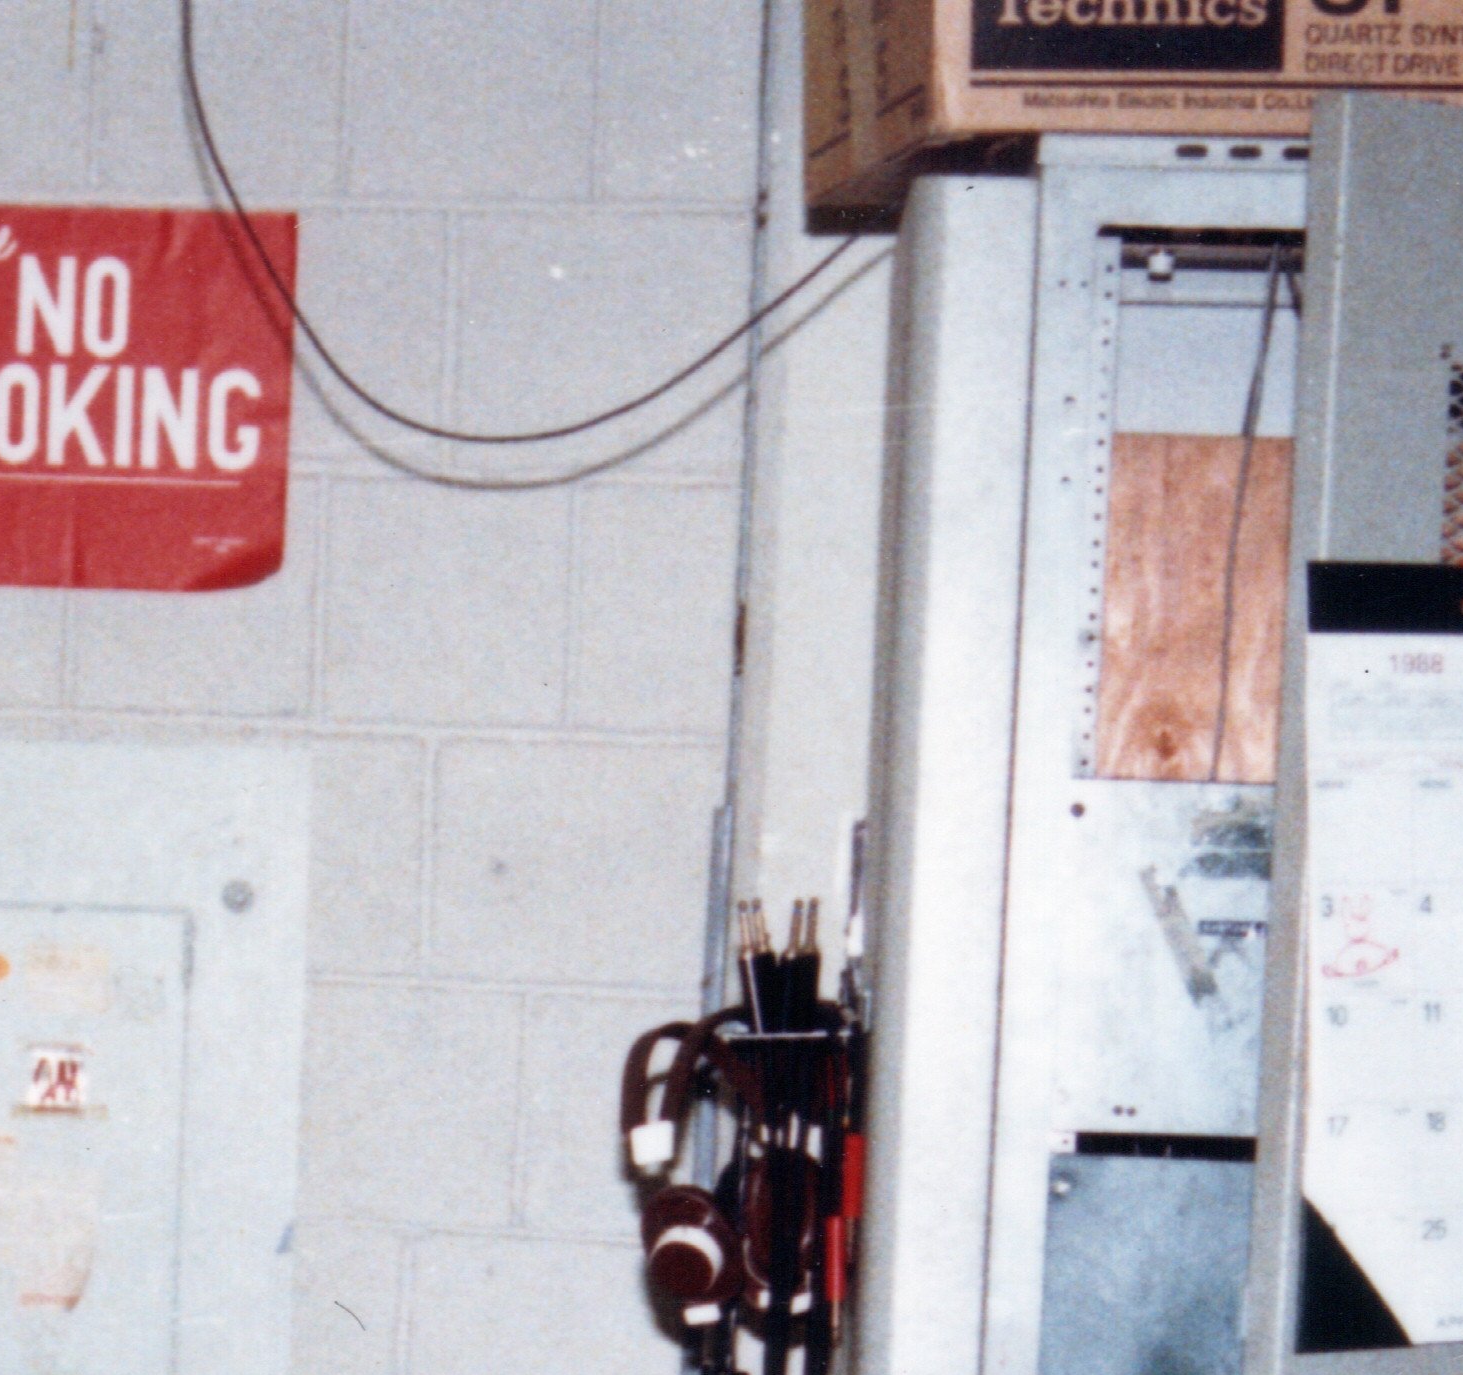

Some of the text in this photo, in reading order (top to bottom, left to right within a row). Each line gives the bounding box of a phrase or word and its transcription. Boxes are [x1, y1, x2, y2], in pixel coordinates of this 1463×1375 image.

[1305, 23, 1401, 46] QUARTZ
[1305, 52, 1385, 74] DIRECT
[1393, 54, 1460, 75] DRIVE
[16, 253, 131, 358] NO
[1389, 653, 1445, 675] 1988
